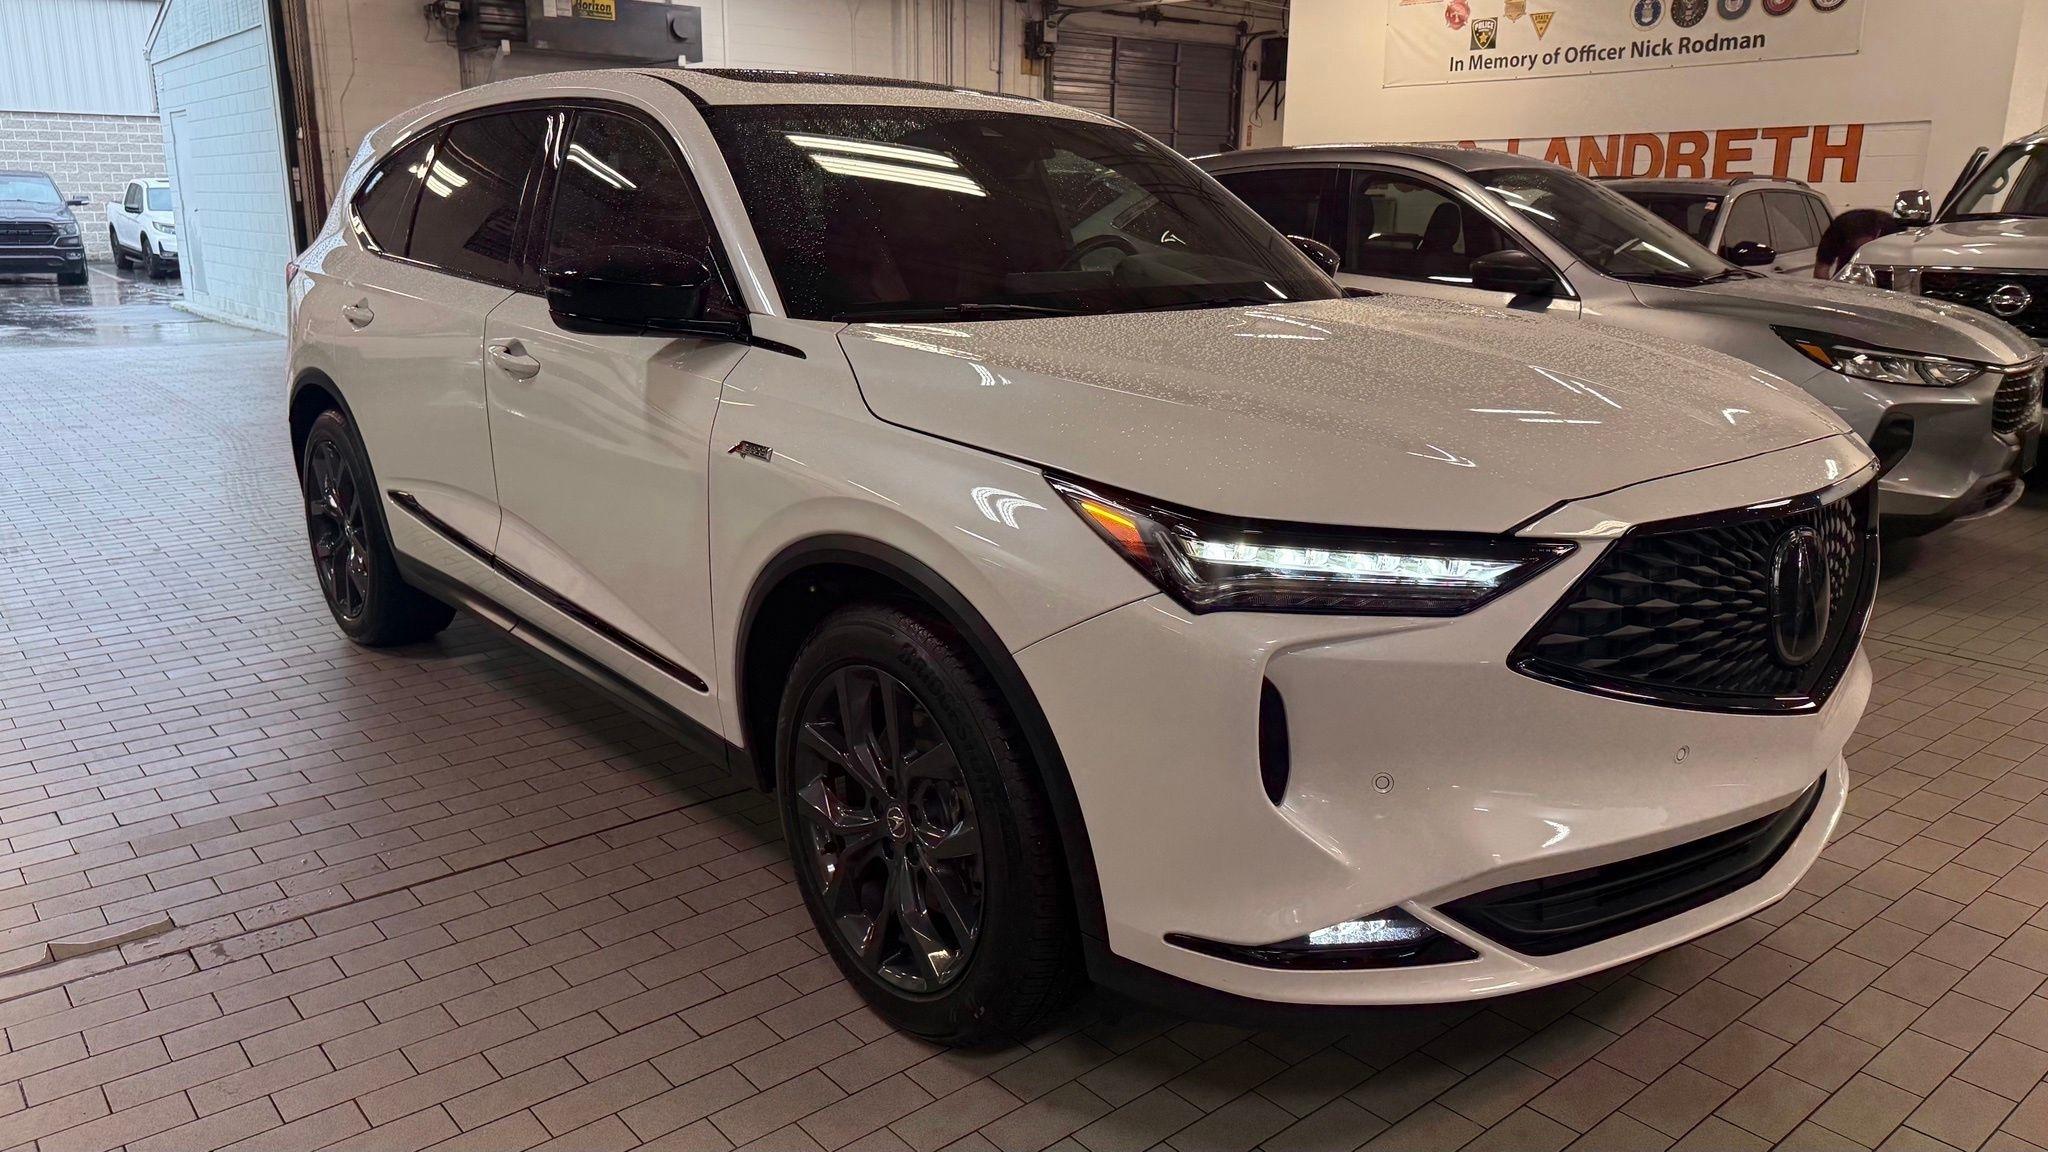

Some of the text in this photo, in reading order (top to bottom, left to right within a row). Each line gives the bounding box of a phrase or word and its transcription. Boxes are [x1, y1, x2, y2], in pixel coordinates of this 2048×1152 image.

[1474, 20, 1494, 31] POLICE
[1449, 33, 1766, 72] In Memory of Officer Nick Rodman
